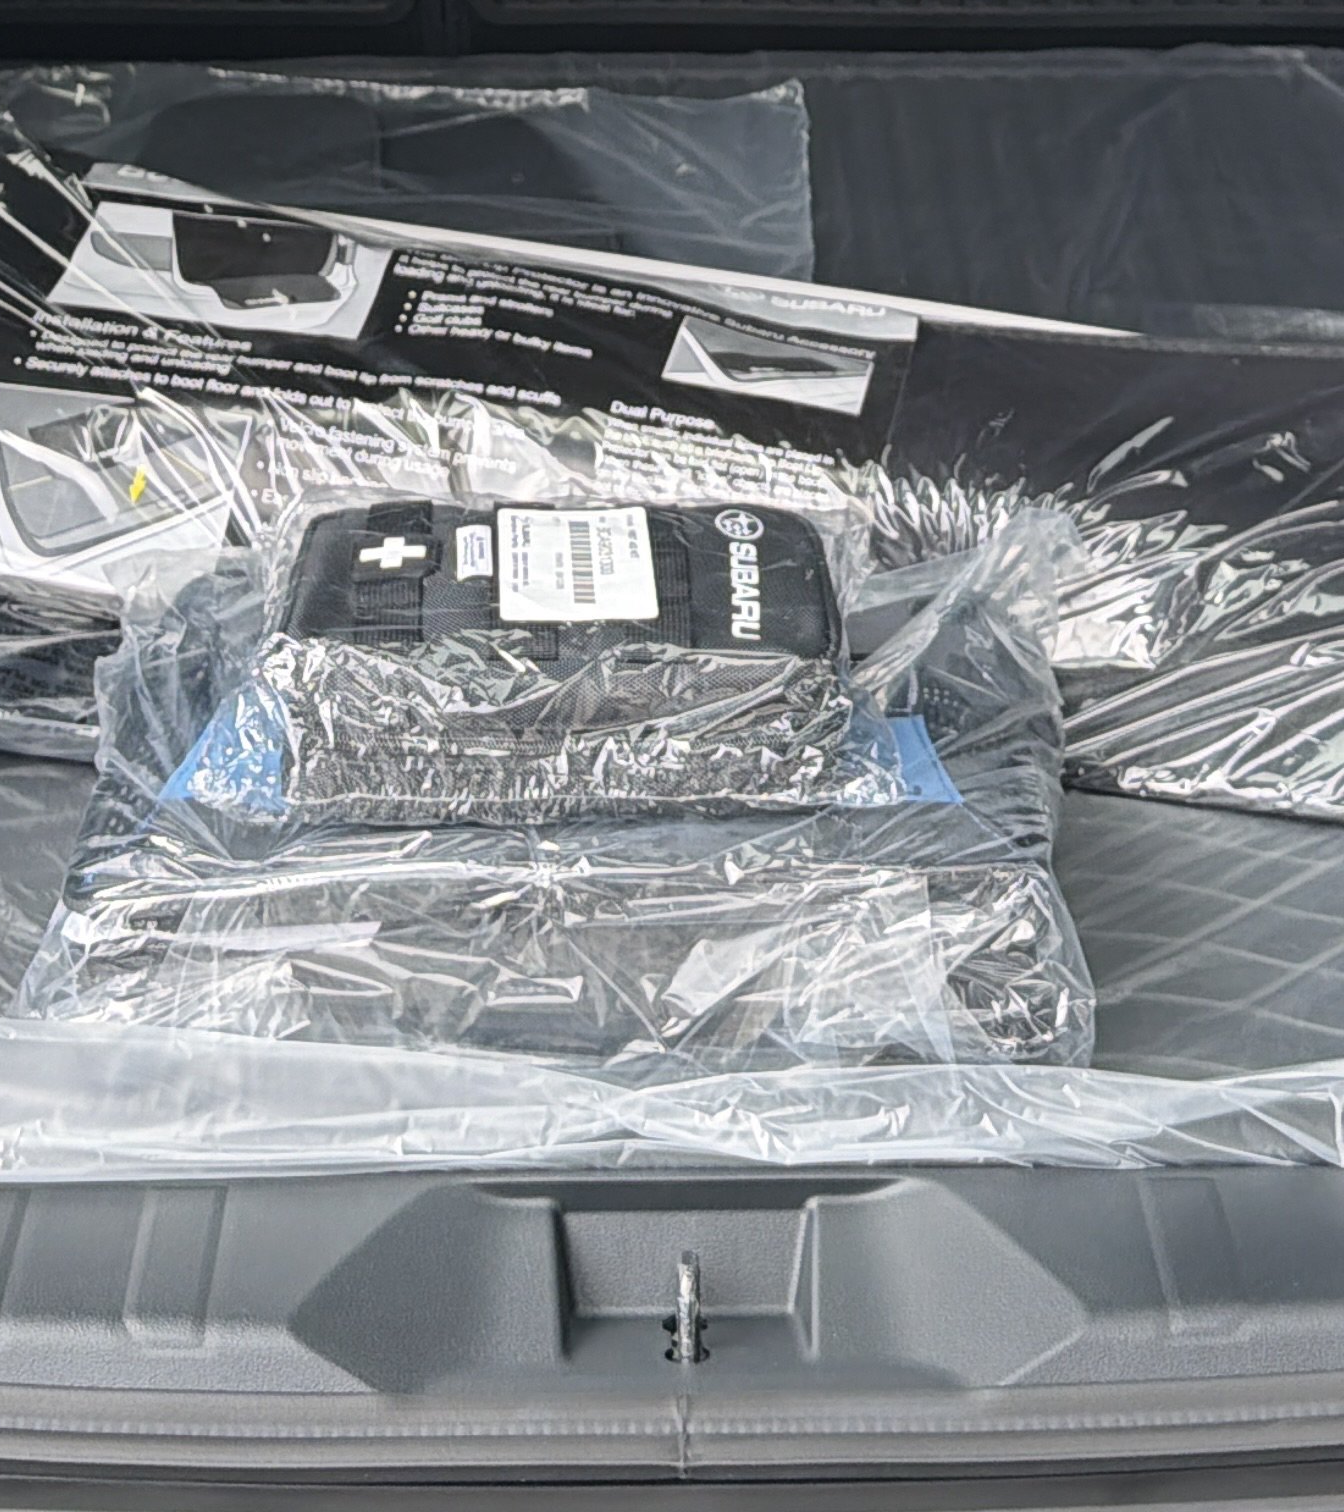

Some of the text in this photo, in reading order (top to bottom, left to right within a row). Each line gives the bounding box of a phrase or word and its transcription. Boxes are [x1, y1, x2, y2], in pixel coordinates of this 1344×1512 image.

[771, 295, 886, 318] SUBARU
[33, 310, 138, 338] Installation
[164, 329, 252, 352] Features
[25, 356, 89, 377] Securely
[90, 365, 151, 383] attaches
[153, 372, 170, 384] to
[170, 373, 205, 388] boot
[205, 378, 239, 394] floor
[308, 394, 335, 408] out
[414, 376, 484, 394] scratches
[486, 385, 516, 398] and
[517, 388, 561, 406] scuffs
[610, 400, 716, 430] Dual Purpose
[329, 426, 395, 452] fastening
[728, 540, 762, 642] SUBARU
